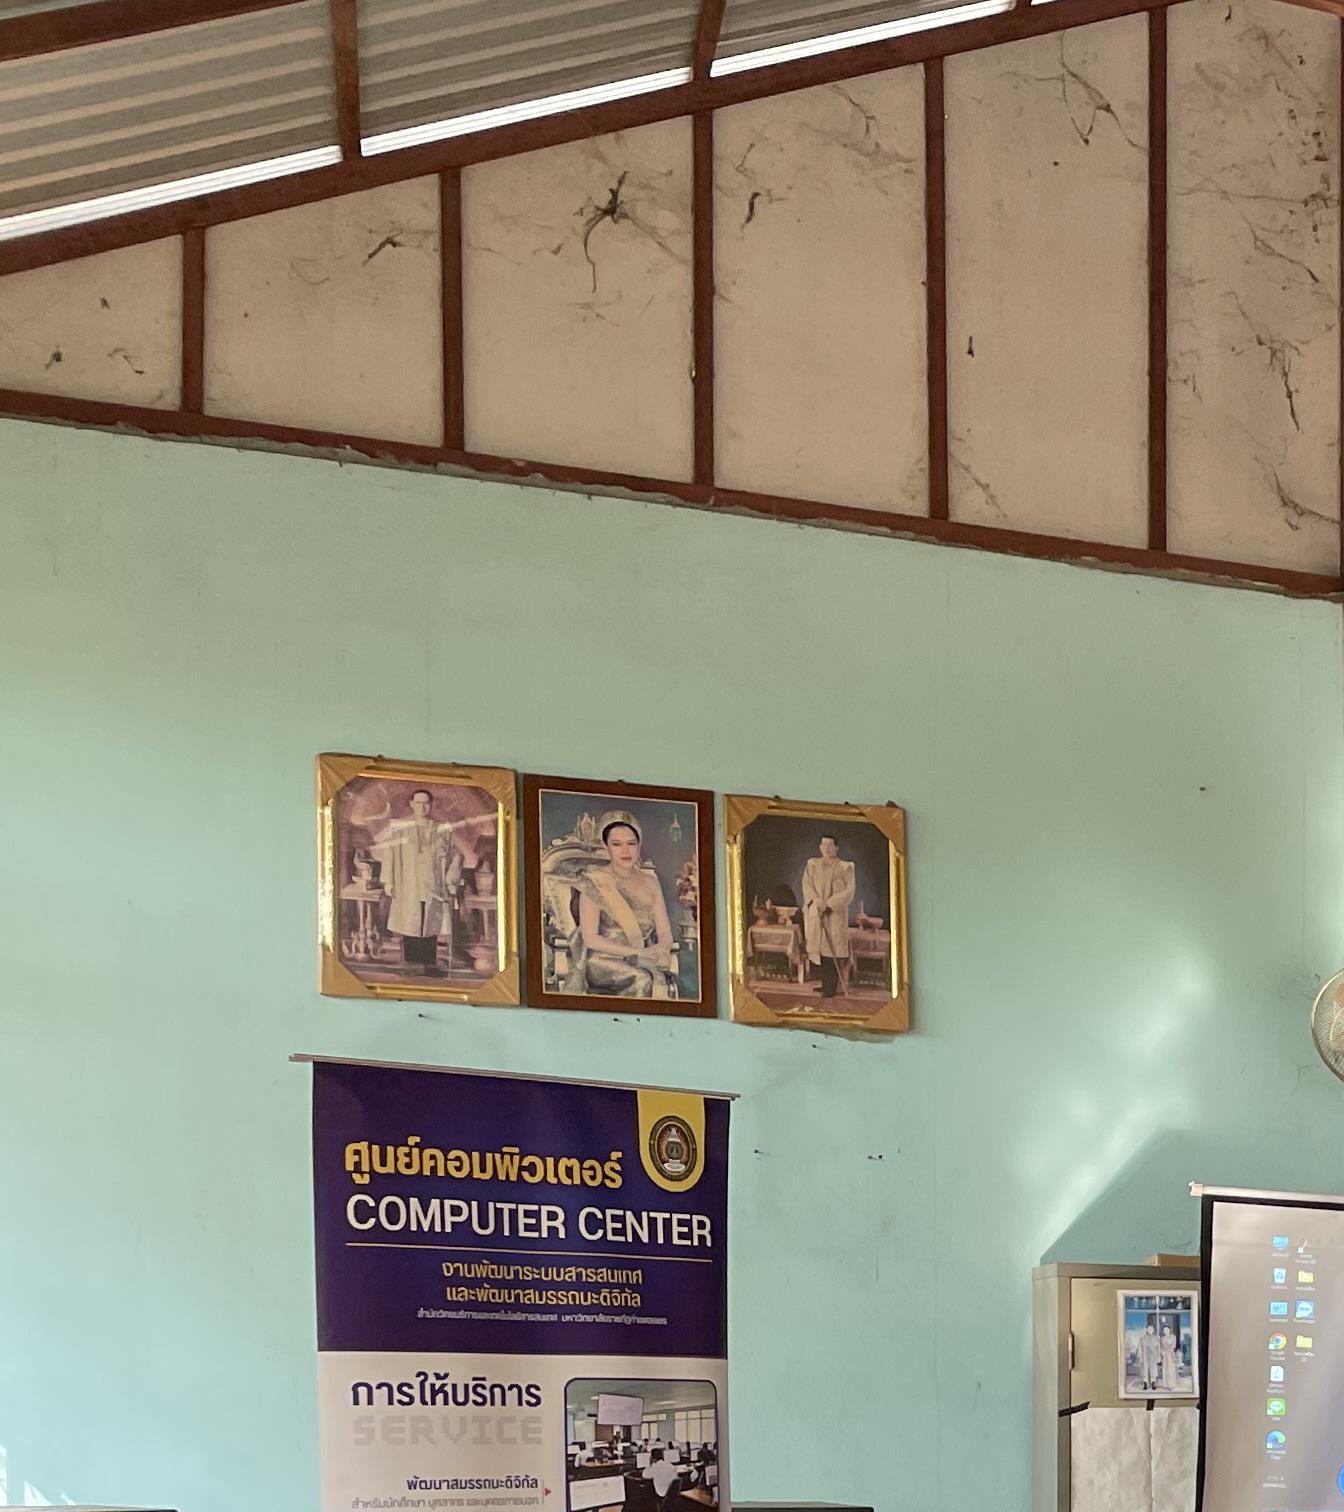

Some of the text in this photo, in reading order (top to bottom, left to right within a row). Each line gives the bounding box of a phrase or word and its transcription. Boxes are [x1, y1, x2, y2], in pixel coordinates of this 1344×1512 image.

[344, 1135, 623, 1190] ศูนย์คอมพิวเตอร์
[346, 1194, 713, 1248] COMPUTER CENTER
[442, 1259, 643, 1285] งานพัฒนาระบบสารสนเทศ
[446, 1283, 641, 1307] และพัฒนาสมรรถนะดิจิทัล
[352, 1371, 543, 1408] การให้บริการ
[353, 1414, 543, 1446] SERVICE
[406, 1475, 538, 1491] พัฒนาสมรรถนะดิจิทัล
